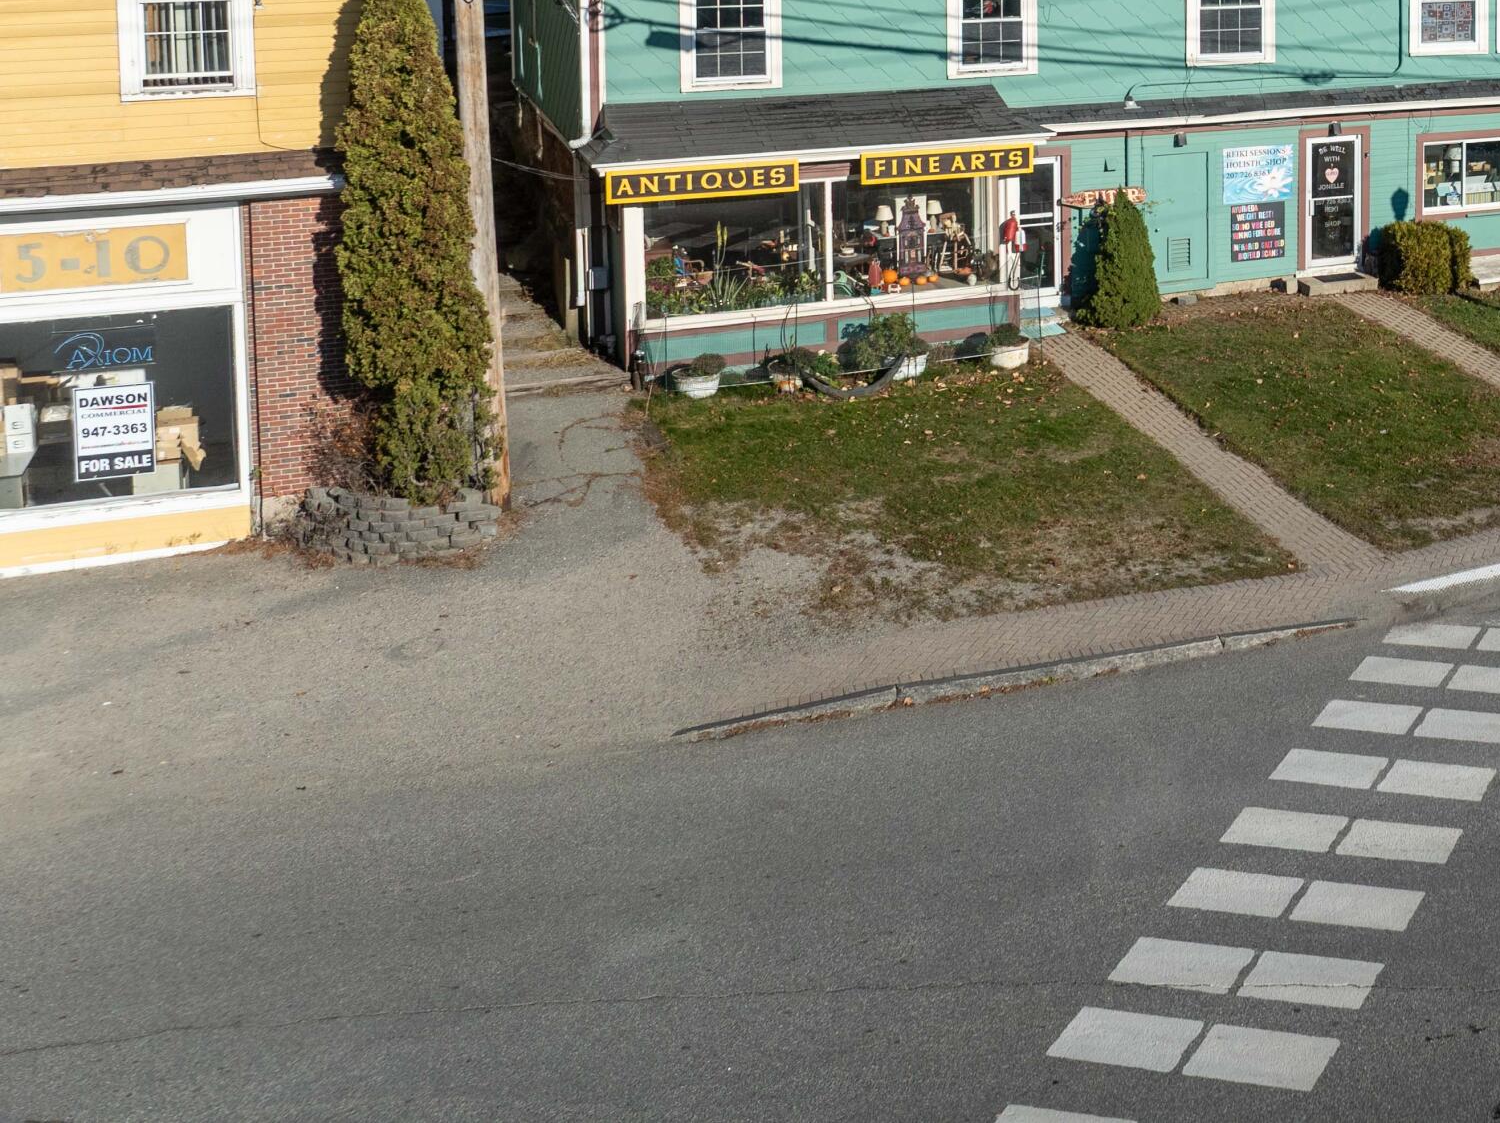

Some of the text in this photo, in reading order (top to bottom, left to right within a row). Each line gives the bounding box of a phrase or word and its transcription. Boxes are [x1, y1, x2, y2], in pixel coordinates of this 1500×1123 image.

[1226, 147, 1286, 159] REIKI SESSIONS
[874, 149, 1023, 177] FINE ARTS
[1226, 157, 1287, 169] HOLISTIC SHOP
[616, 167, 787, 196] ANTIQUES
[1240, 171, 1252, 179] 726
[16, 235, 171, 284] 5-10
[60, 336, 154, 370] AXIOM
[79, 392, 148, 408] DAWSON
[81, 408, 149, 420] COMMERCIAL
[81, 422, 148, 438] 947-3363
[79, 453, 152, 474] FOR SALE
